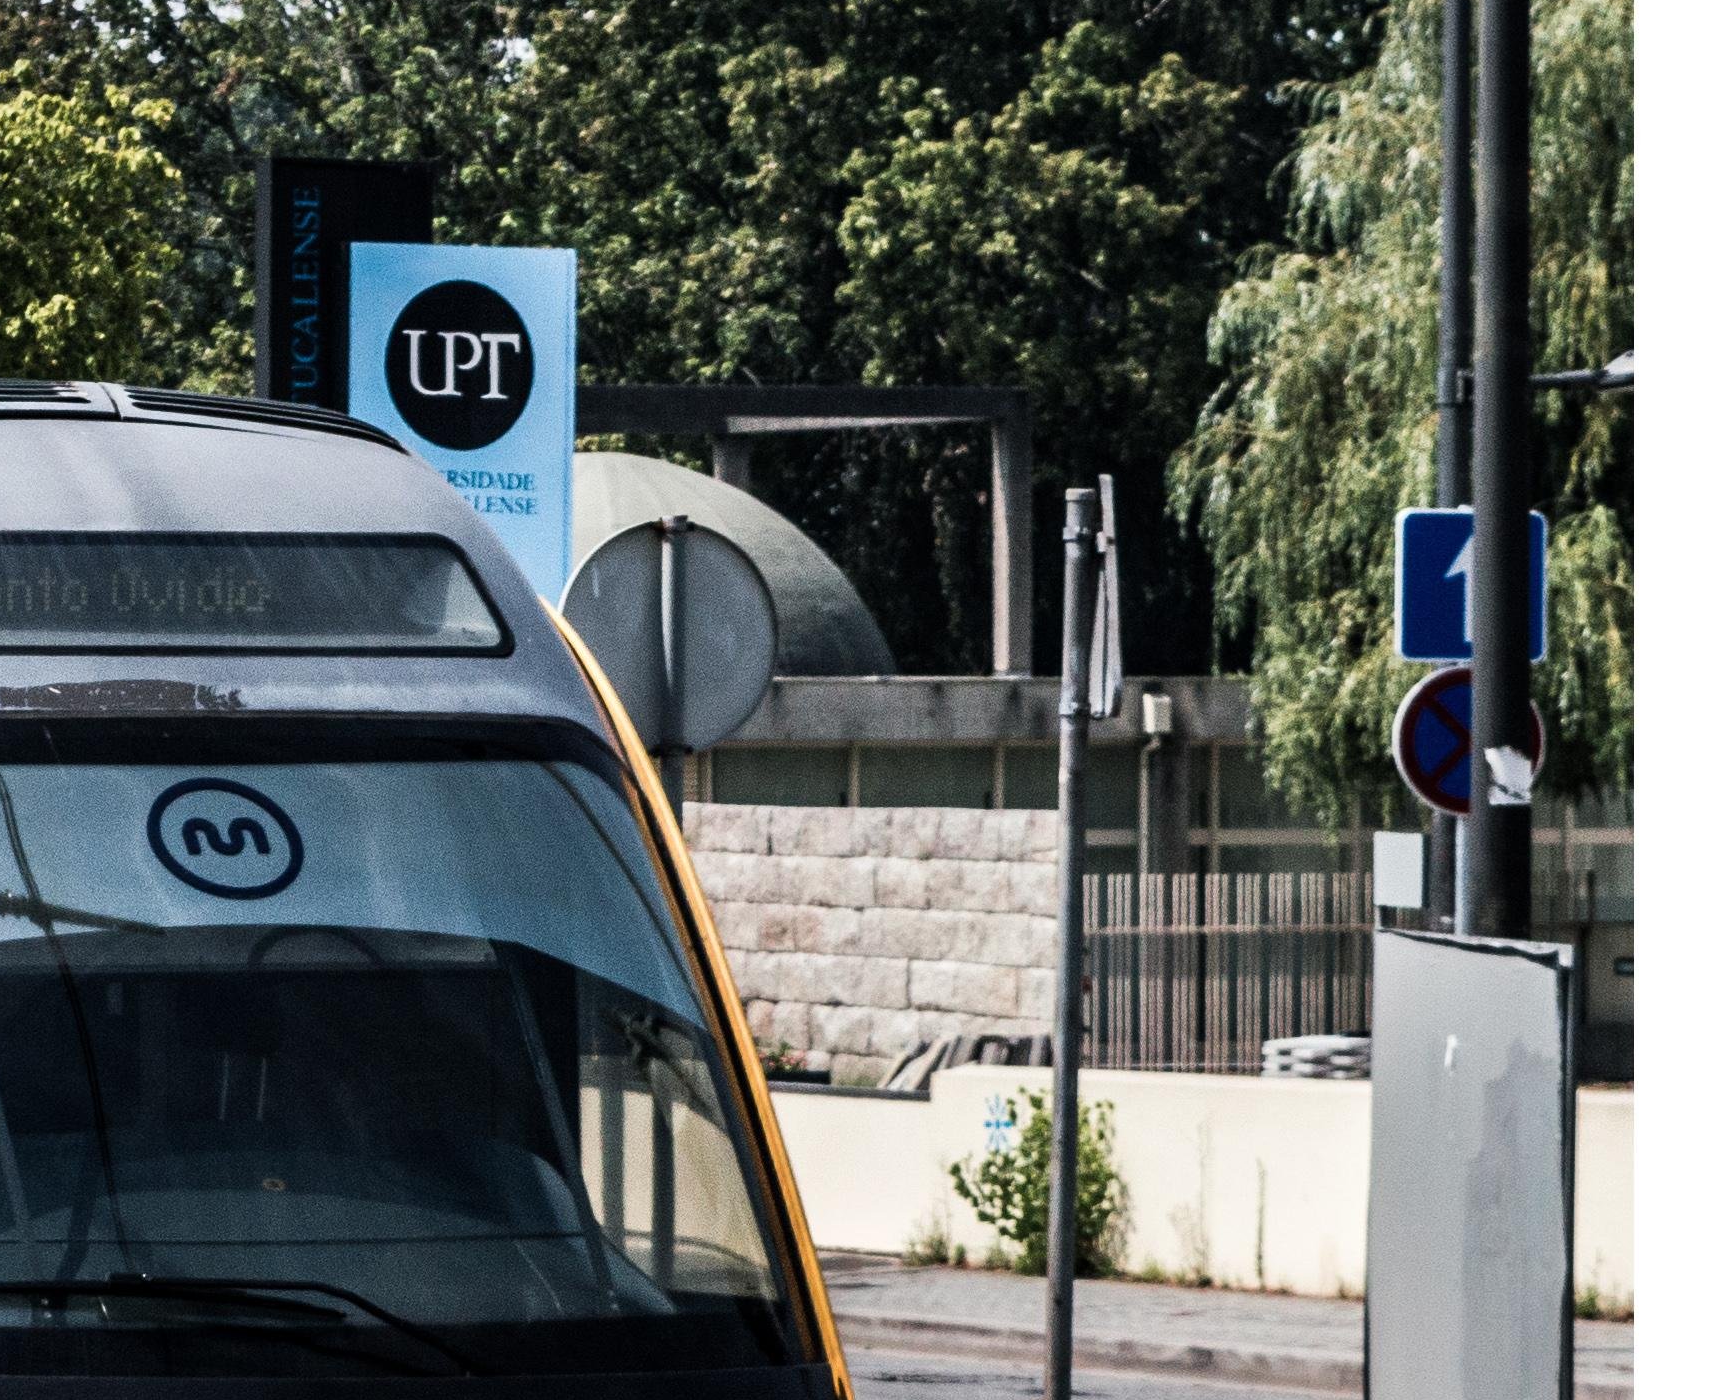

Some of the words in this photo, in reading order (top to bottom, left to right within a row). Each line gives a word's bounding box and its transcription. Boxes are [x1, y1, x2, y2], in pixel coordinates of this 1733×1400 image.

[291, 185, 321, 399] UCALENSE
[402, 330, 521, 399] UPT
[439, 469, 537, 492] RSIDADE
[463, 495, 538, 516] LENSE
